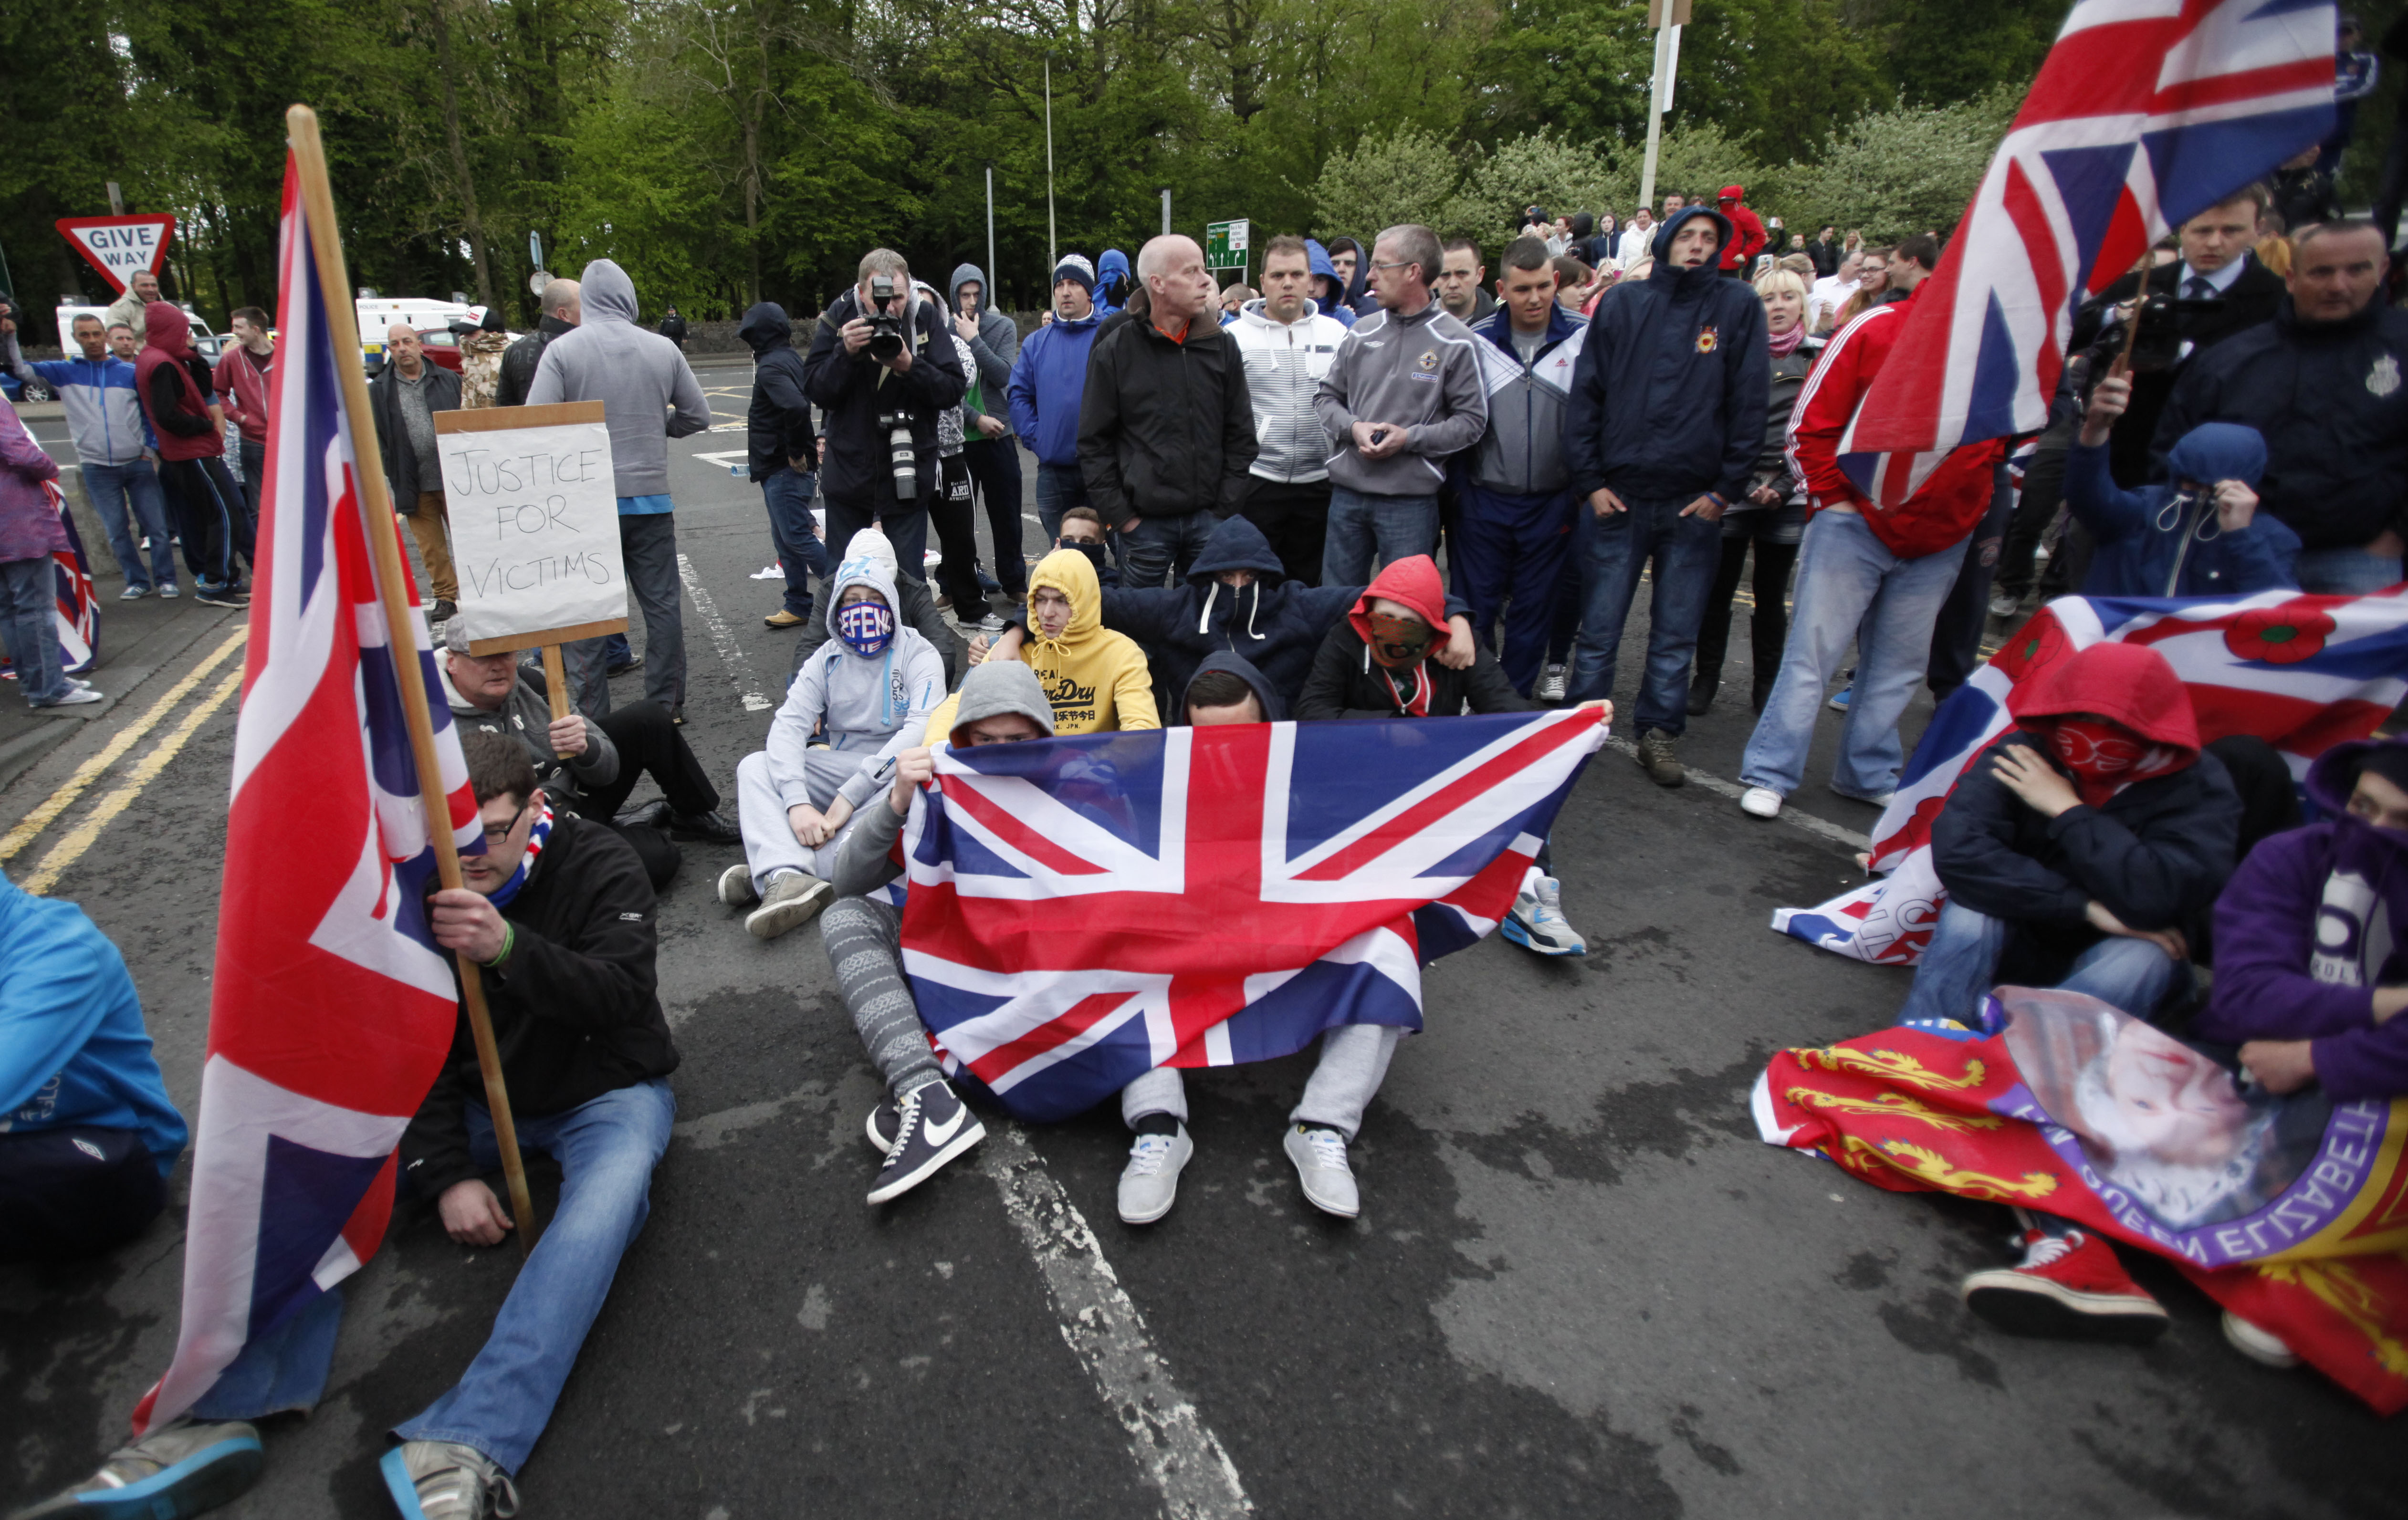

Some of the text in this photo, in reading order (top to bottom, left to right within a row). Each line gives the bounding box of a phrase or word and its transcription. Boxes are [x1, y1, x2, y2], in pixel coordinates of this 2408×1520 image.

[89, 227, 154, 249] GIVE
[104, 251, 147, 266] WAY
[450, 448, 603, 496] JUSTICE
[497, 494, 580, 541] FOR
[467, 552, 610, 598] VICTIMS
